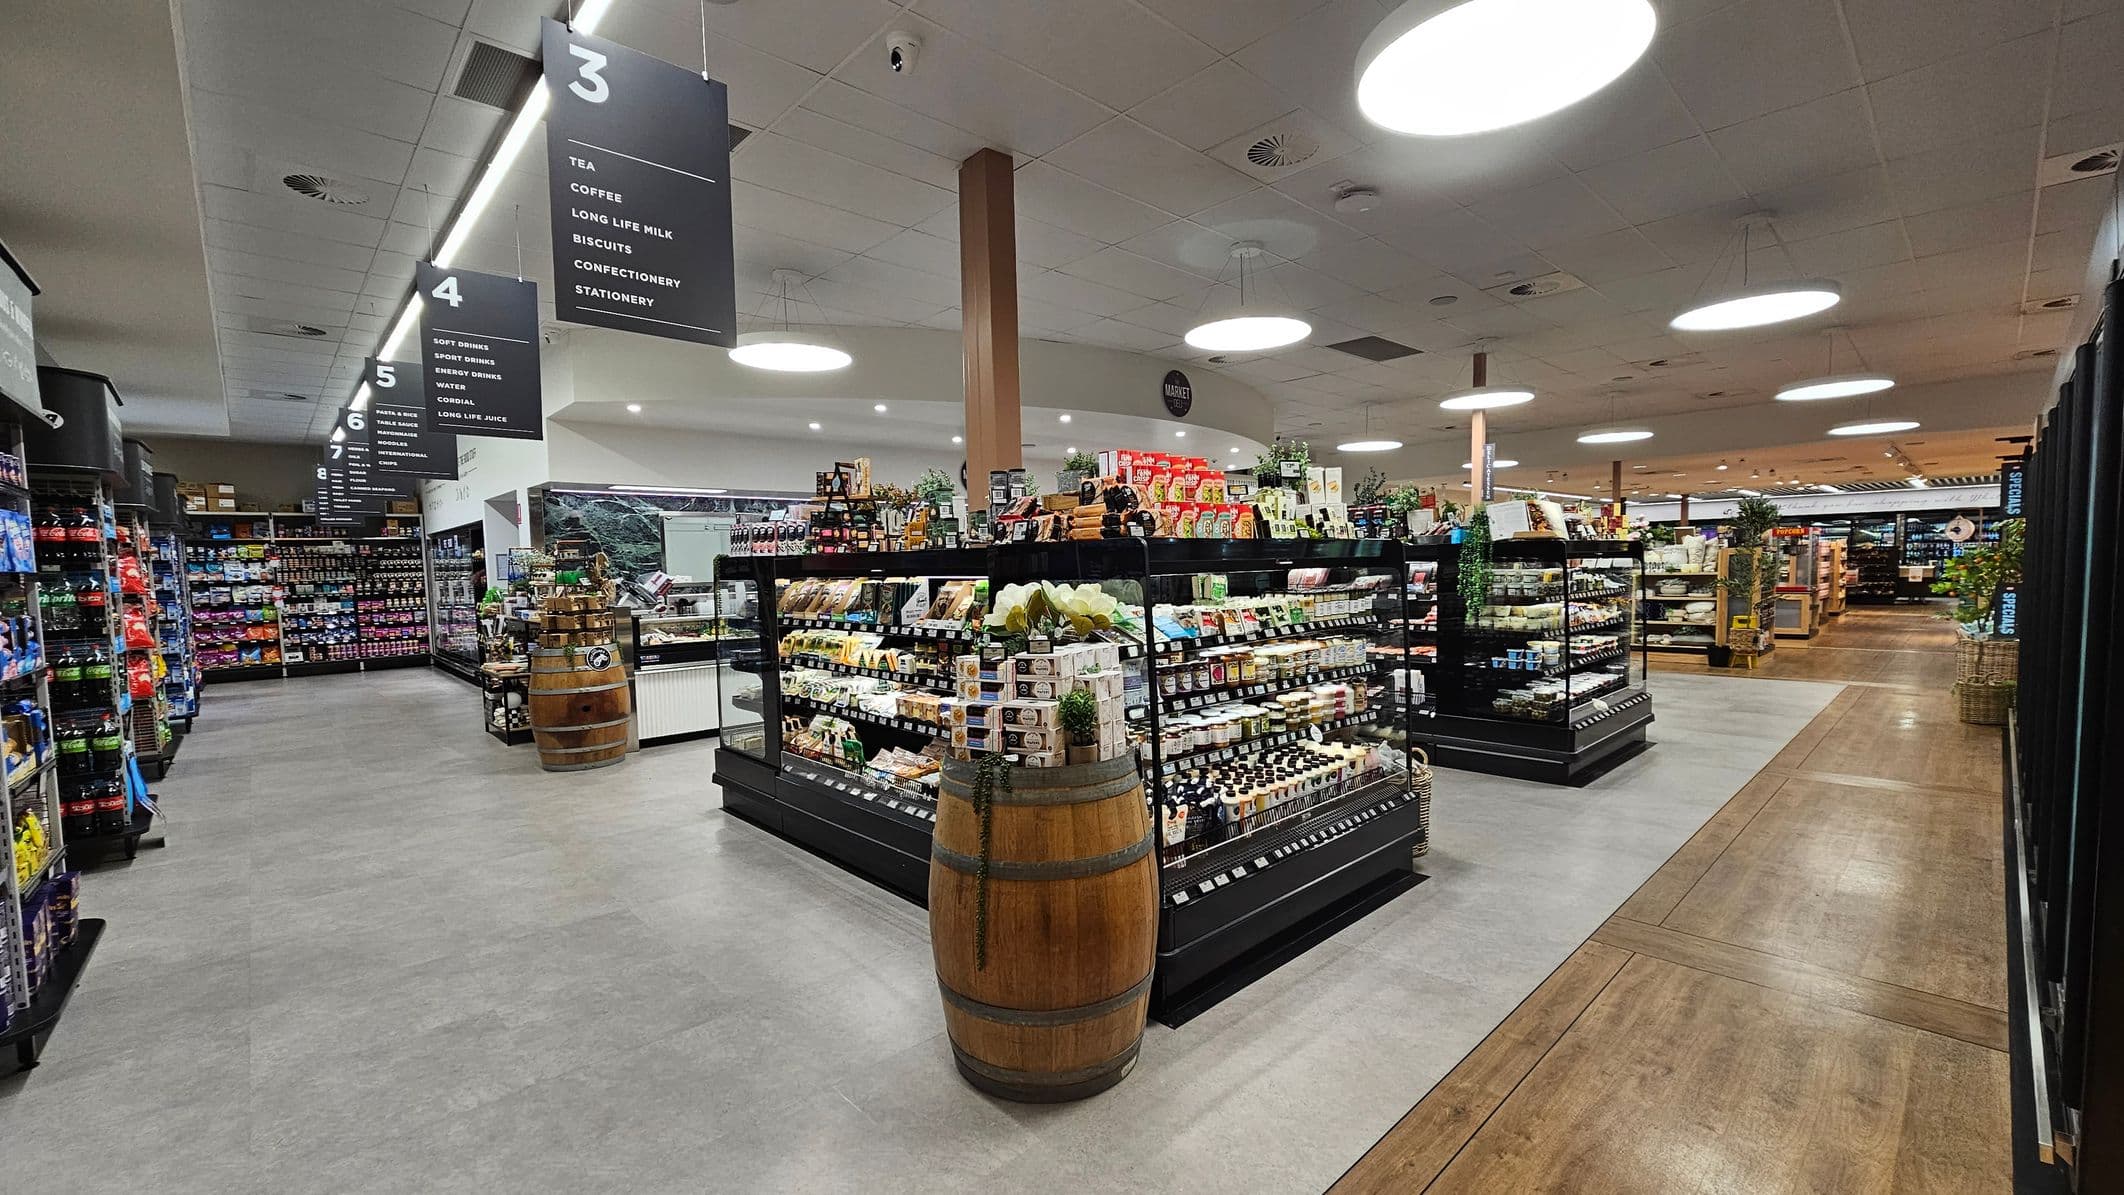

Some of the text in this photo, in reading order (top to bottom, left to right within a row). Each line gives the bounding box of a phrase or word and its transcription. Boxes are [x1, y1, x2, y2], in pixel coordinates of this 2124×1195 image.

[568, 43, 610, 104] 3
[569, 156, 596, 172] TEA
[570, 182, 622, 203] COFFEE
[572, 208, 673, 240] LONG LIFE MILK
[573, 233, 632, 254] BISCUITS
[574, 259, 681, 289] CONFECTIONERY
[432, 276, 463, 308] 4
[575, 284, 654, 307] STATIONERY
[434, 338, 489, 350] SOFT DRINKS
[434, 352, 496, 365] SPORT DRINKS
[376, 366, 396, 388] 5
[435, 368, 502, 380] ENERGY DRINKS
[436, 382, 466, 390] WATER
[1165, 384, 1190, 399] MARKET
[437, 396, 475, 406] CORDIAL
[347, 412, 365, 430] 6
[330, 445, 342, 459] 7
[317, 468, 327, 479] 8
[2007, 472, 2023, 516] SPECIALS
[2000, 592, 2017, 636] SPECIALS
